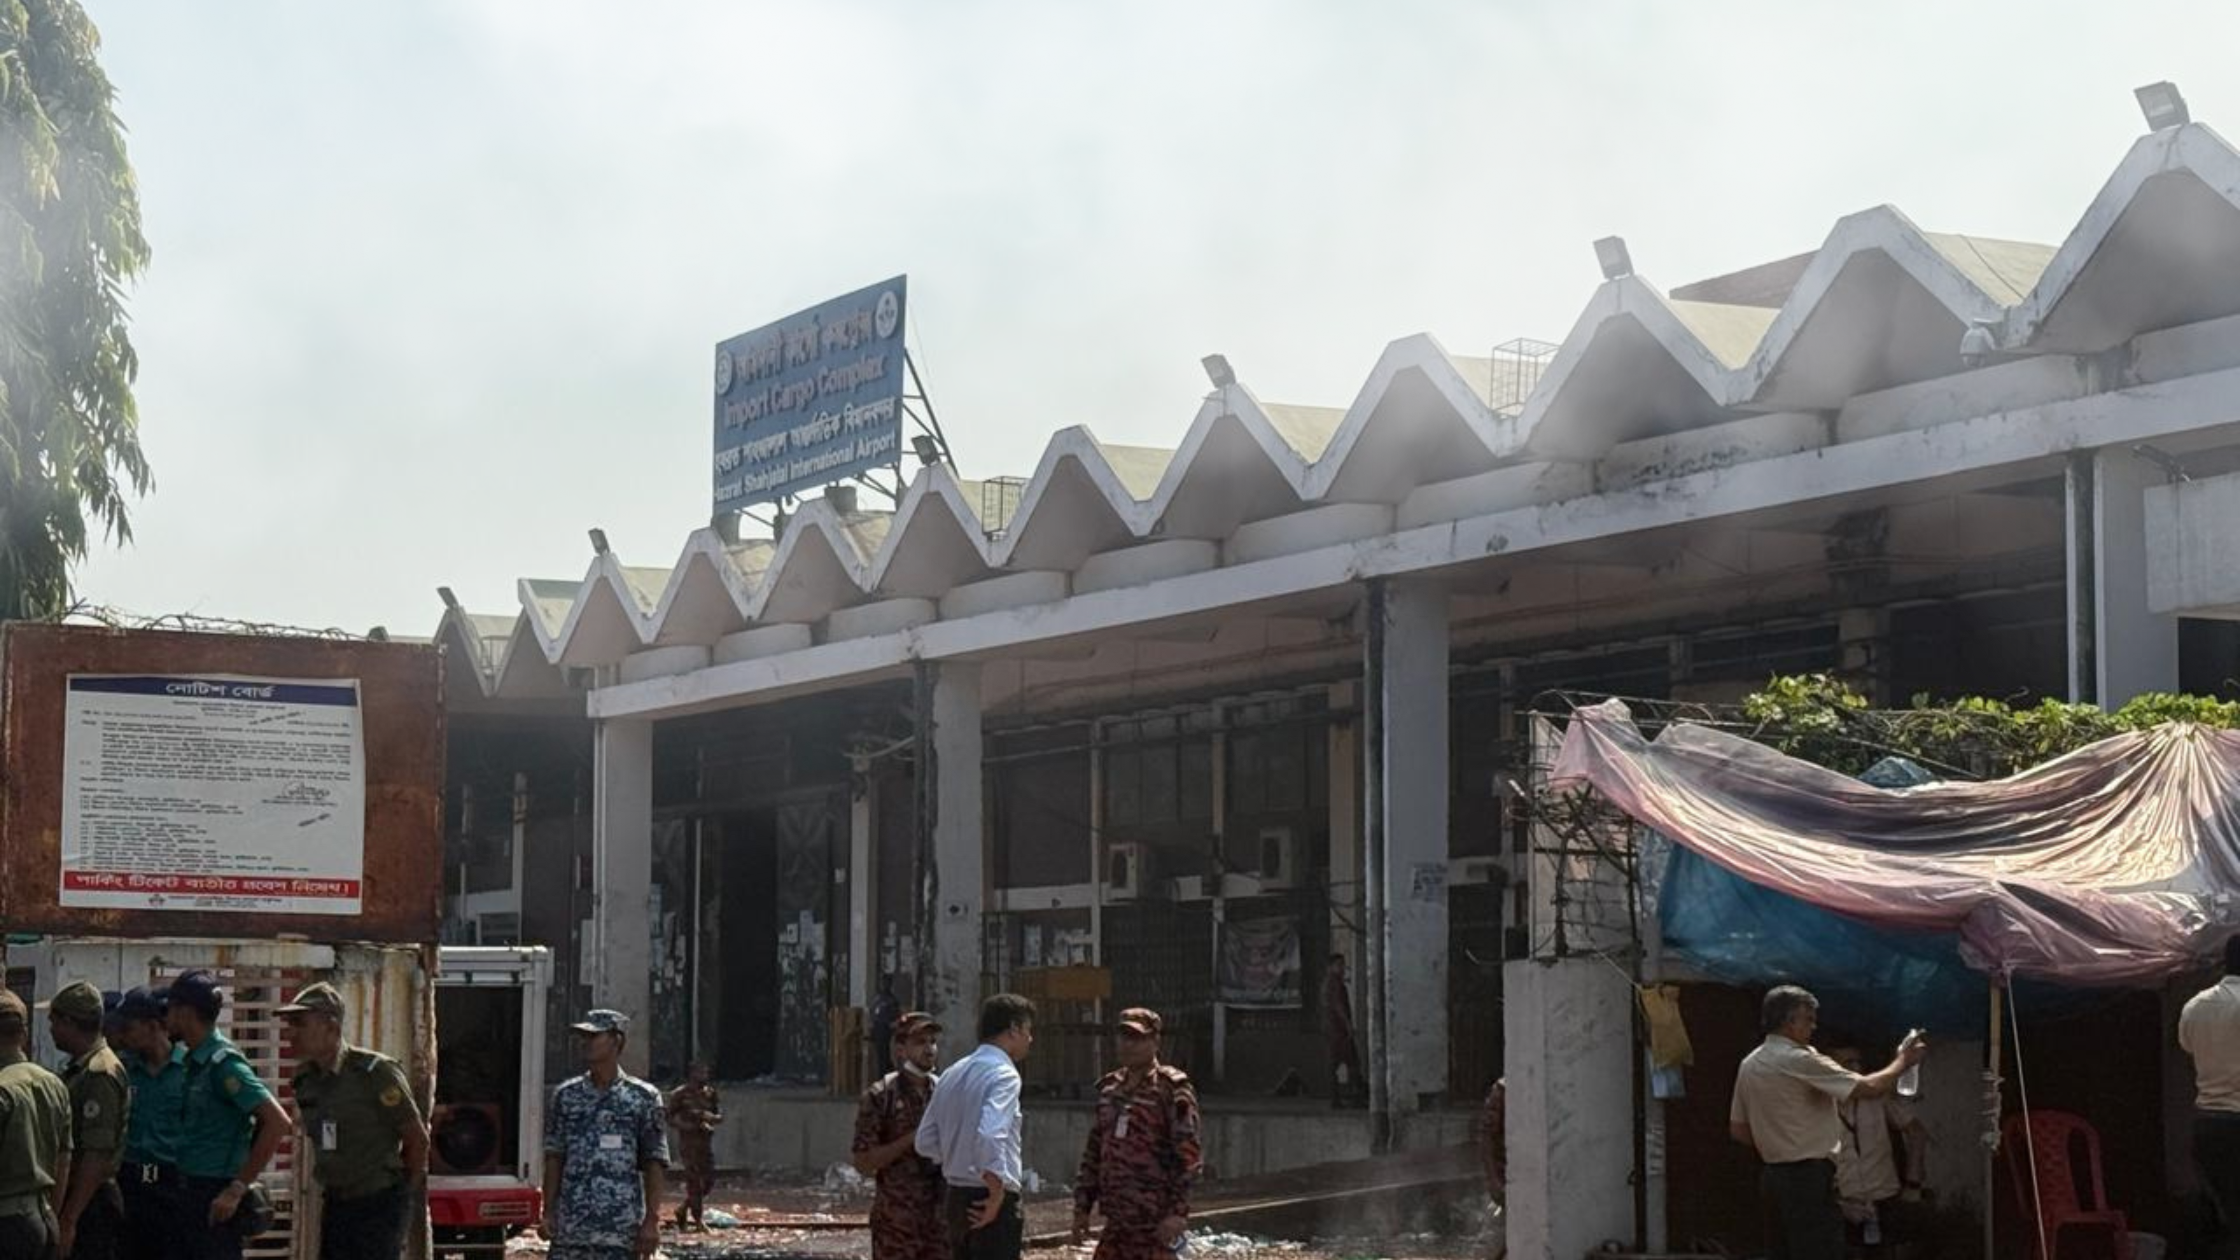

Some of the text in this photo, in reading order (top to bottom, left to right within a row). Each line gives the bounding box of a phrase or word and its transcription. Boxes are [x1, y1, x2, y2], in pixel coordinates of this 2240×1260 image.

[725, 353, 884, 428] Import Cargo Complex
[790, 443, 854, 478] International
[856, 429, 895, 460] Airport
[166, 681, 275, 698] নোটিশ বোর্ড
[76, 873, 123, 888] পার্কিং
[129, 875, 179, 889] টিকেট
[243, 879, 286, 892] প্রবেশ
